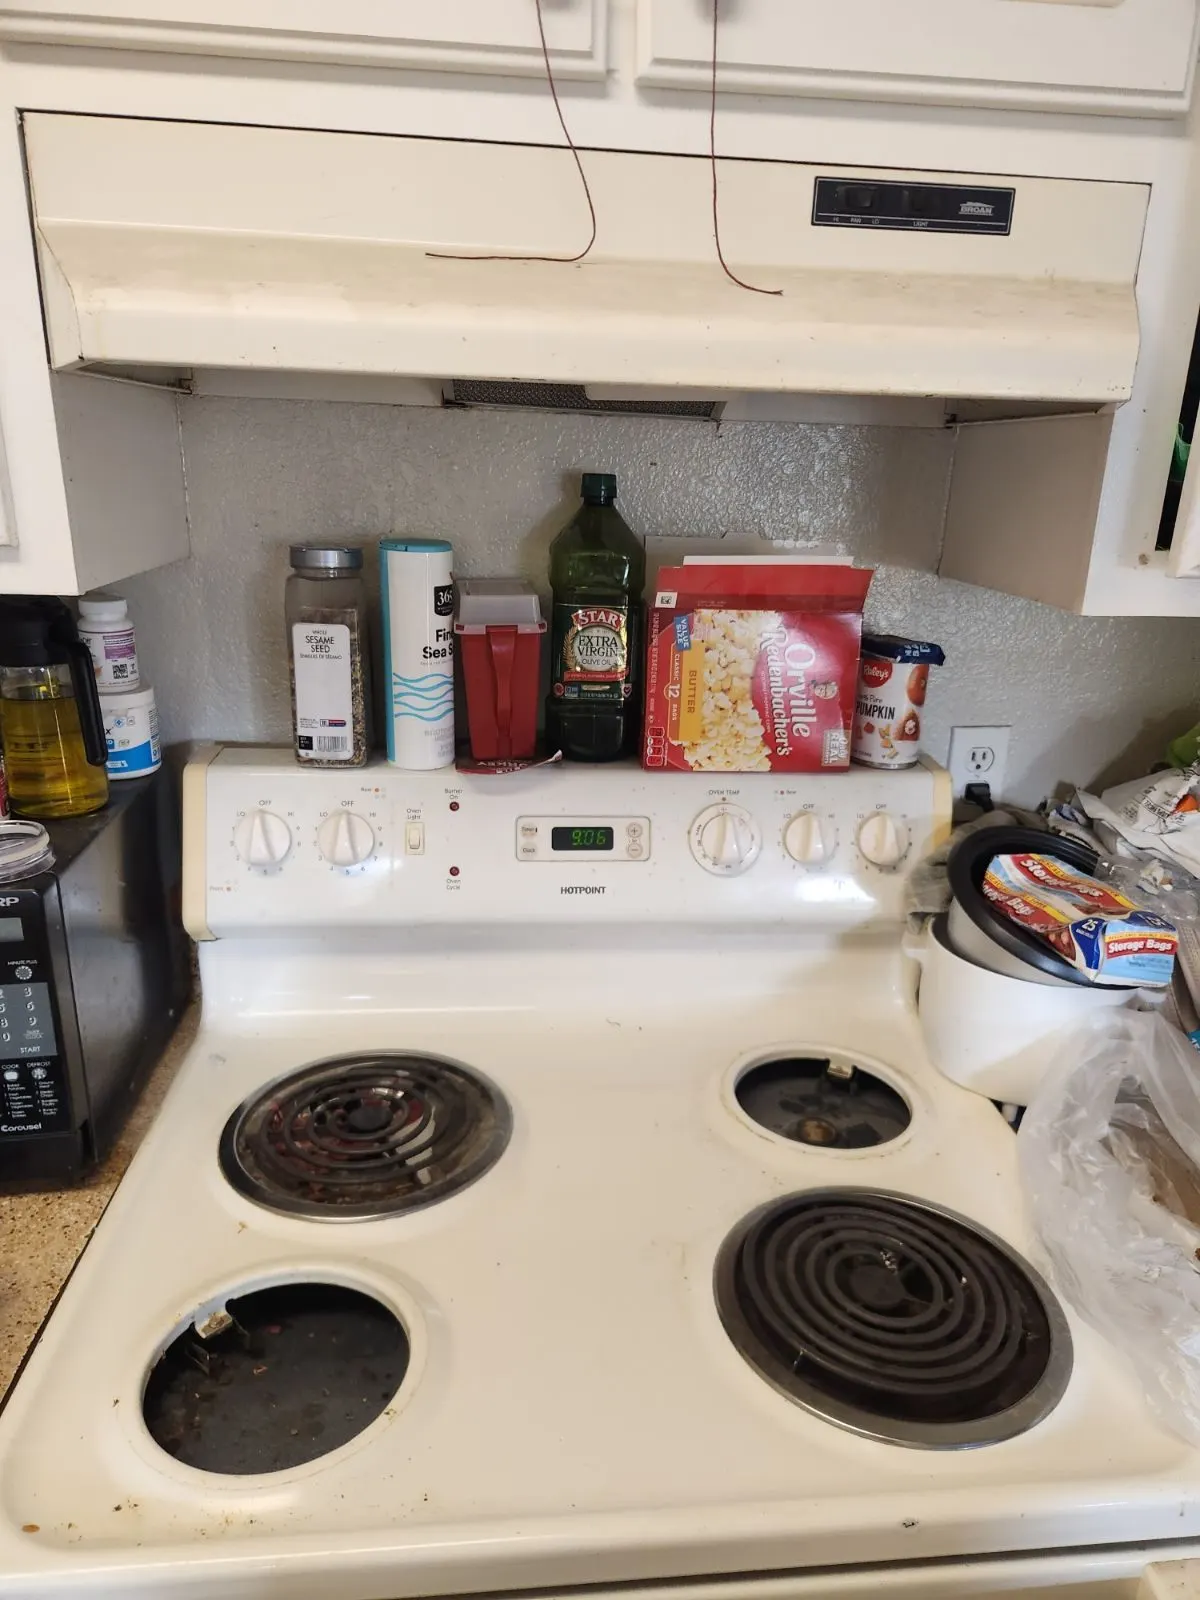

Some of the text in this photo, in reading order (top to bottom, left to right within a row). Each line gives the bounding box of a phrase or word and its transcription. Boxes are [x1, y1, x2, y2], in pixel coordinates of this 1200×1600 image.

[959, 205, 993, 215] BROAN
[579, 610, 619, 627] STAR
[305, 635, 335, 645] SESAME
[435, 628, 453, 643] Fin
[675, 623, 685, 645] SIZE
[680, 617, 691, 649] VALUE
[310, 644, 331, 653] SEED
[579, 635, 618, 648] EXTRA
[422, 645, 447, 660] Sea
[577, 646, 619, 658] VIRGIN
[581, 658, 600, 666] OLIVE
[667, 682, 681, 700] 12
[686, 670, 698, 715] BUTTER
[760, 628, 792, 757] Redenbacher's
[784, 643, 817, 739] Orville
[856, 701, 896, 720] PUMPKIN
[829, 731, 839, 764] REAL
[838, 736, 849, 760] Only
[560, 886, 607, 895] HOTPOINT
[1007, 897, 1036, 915] Bags
[1081, 918, 1099, 931] 25
[1108, 939, 1173, 953] Storage Bags
[24, 986, 33, 998] 3
[26, 1001, 35, 1011] 6
[28, 1016, 37, 1026] 9
[20, 1045, 41, 1053] START
[0, 1122, 42, 1132] Carousel
